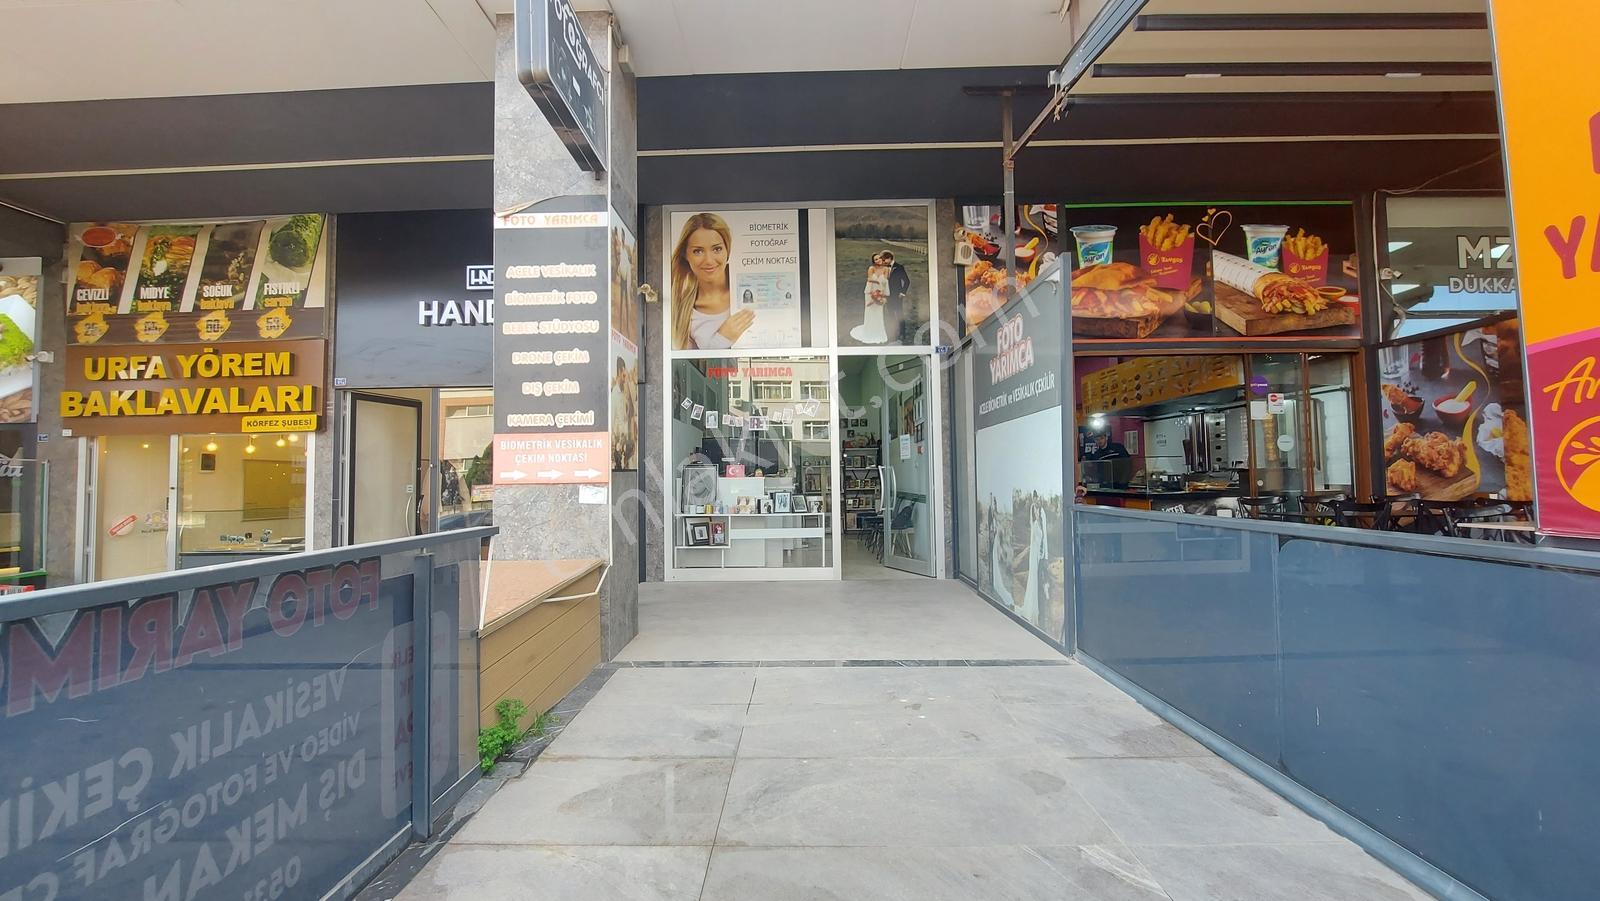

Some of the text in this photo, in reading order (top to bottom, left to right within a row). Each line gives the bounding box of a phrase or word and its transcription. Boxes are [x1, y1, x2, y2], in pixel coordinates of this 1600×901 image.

[503, 214, 598, 226] FOTO YARIMCA
[749, 222, 789, 231] BİOMETRİK
[750, 237, 789, 247] FOTOĞRAF
[1255, 243, 1278, 255] Ayran
[741, 256, 798, 266] ÇEKİM NOKTASI
[506, 262, 597, 279] ACELE VESİKALIK
[140, 285, 170, 299] MİDYE
[203, 282, 233, 297] SOĞUK
[1450, 274, 1516, 293] DÜKKA
[505, 290, 598, 306] BİOMETRİK FOTO
[503, 318, 600, 335] BEBEK STÜDYOSU
[997, 313, 1024, 352] FOTO
[84, 347, 292, 381] URFA YÖREM
[512, 347, 590, 366] DRONE ÇEKİM
[989, 336, 1035, 385] YARIMCA
[742, 367, 793, 378] YARIMCA
[522, 378, 580, 397] DIŞ ÇEKİM
[1012, 382, 1035, 402] VESİKALIK
[1034, 370, 1055, 397] ÇEKİLİR
[60, 384, 313, 418] BAKLAVALARI
[281, 418, 312, 428] ŞUBESİ
[507, 410, 595, 428] KAMERA ÇEKİMİ
